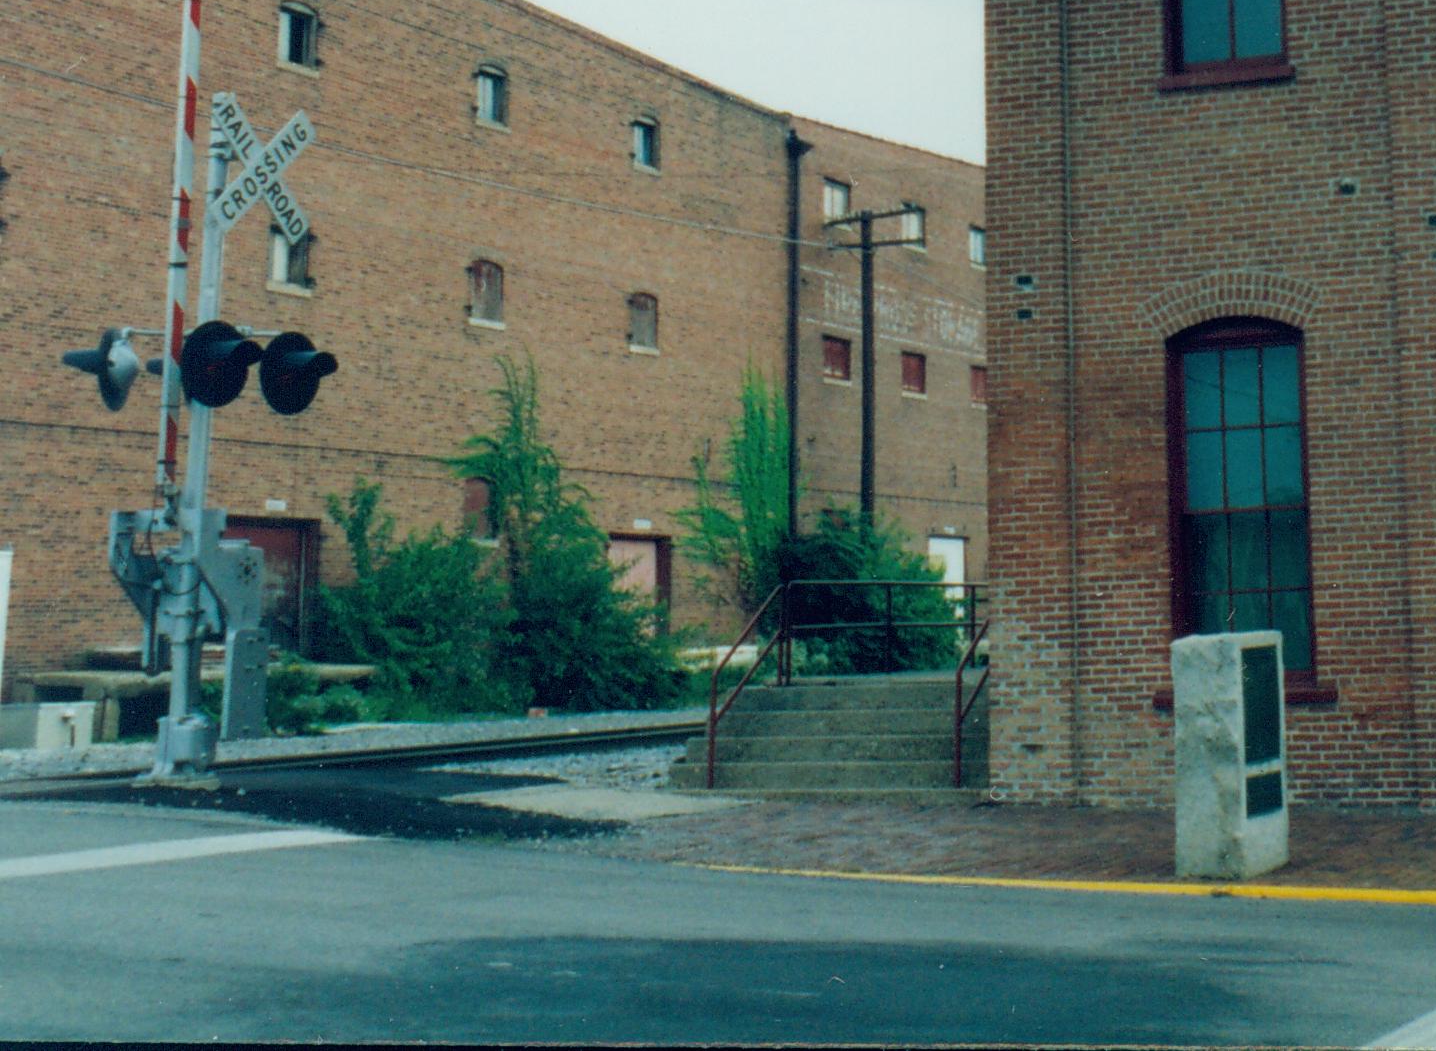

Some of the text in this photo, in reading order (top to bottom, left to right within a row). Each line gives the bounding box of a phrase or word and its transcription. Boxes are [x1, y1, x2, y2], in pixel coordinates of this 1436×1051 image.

[219, 104, 304, 237] RAIL ROAD
[221, 123, 308, 220] CROSSING
